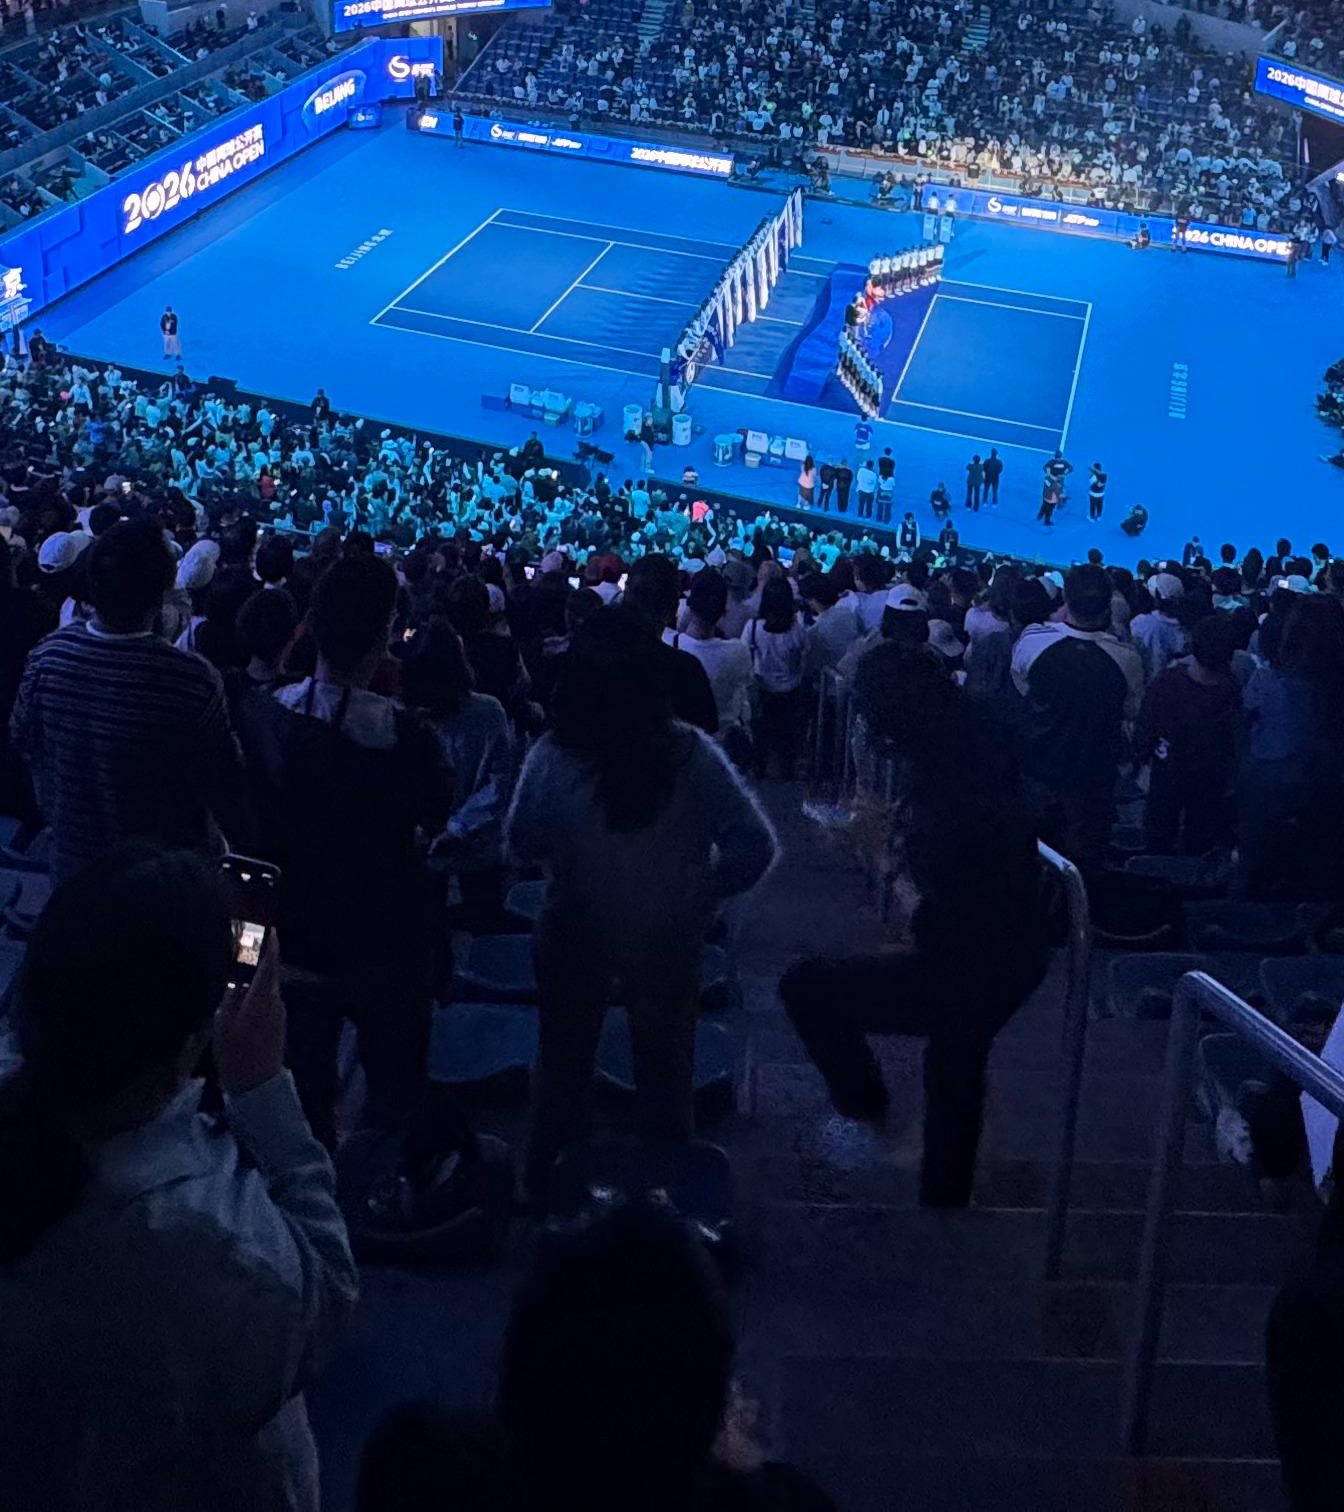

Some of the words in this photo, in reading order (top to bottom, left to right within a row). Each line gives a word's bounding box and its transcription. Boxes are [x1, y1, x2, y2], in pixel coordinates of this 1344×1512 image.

[313, 76, 356, 116] BEIJING
[123, 160, 196, 235] 2026
[196, 160, 234, 191] CHINA
[232, 139, 265, 170] OPEN
[1209, 232, 1255, 251] CHINA
